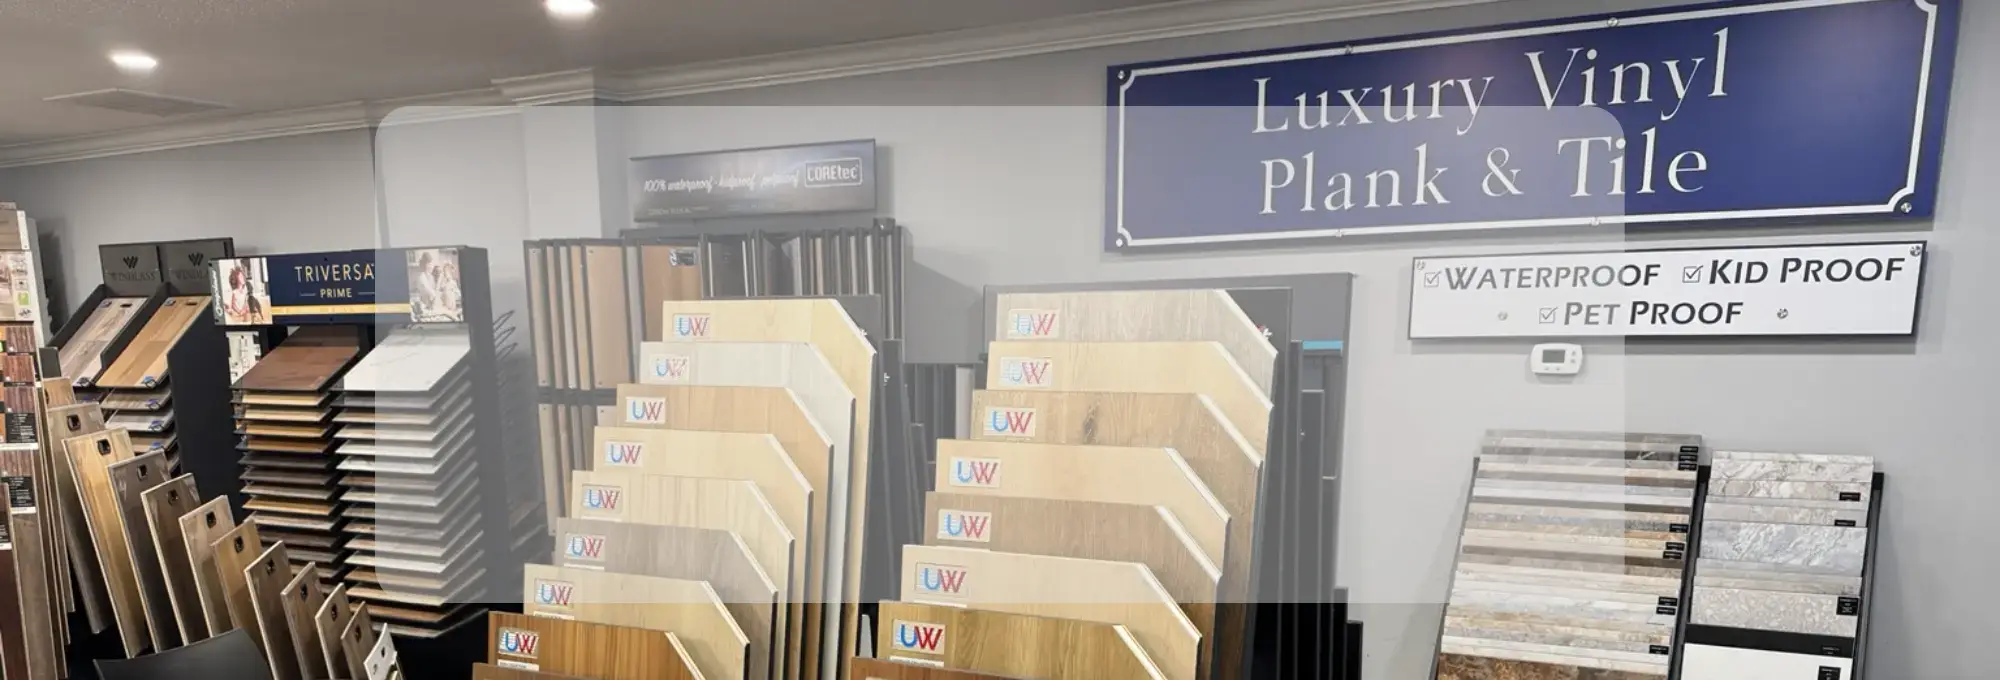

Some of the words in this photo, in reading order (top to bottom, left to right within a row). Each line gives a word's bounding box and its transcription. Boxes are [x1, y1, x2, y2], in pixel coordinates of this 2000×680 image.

[1252, 75, 1495, 136] Luxury
[1524, 27, 1729, 121] Vinyl
[644, 179, 667, 193] 100%
[807, 164, 858, 181] COREtec
[1258, 142, 1451, 215] Plank
[1481, 146, 1525, 197] &
[1557, 126, 1708, 198] Tile
[294, 263, 375, 283] TRIVERSA
[1445, 263, 1661, 290] WATERPROOF
[1709, 258, 1769, 284] KID
[1780, 256, 1905, 284] PROOF
[320, 287, 353, 299] PRIME
[1015, 313, 1056, 335] UW
[1563, 300, 1620, 326] PET
[1629, 299, 1744, 326] PROOF
[677, 317, 710, 336] UW
[631, 400, 663, 420] UW
[991, 410, 1034, 434] UW
[611, 444, 641, 464] UW
[957, 460, 998, 484] UW
[589, 489, 620, 509] UW
[947, 514, 988, 538] UW
[572, 536, 603, 558] UW
[924, 567, 967, 594] UW
[541, 583, 573, 605] UW
[504, 632, 538, 654] UW
[900, 624, 944, 651] UW
